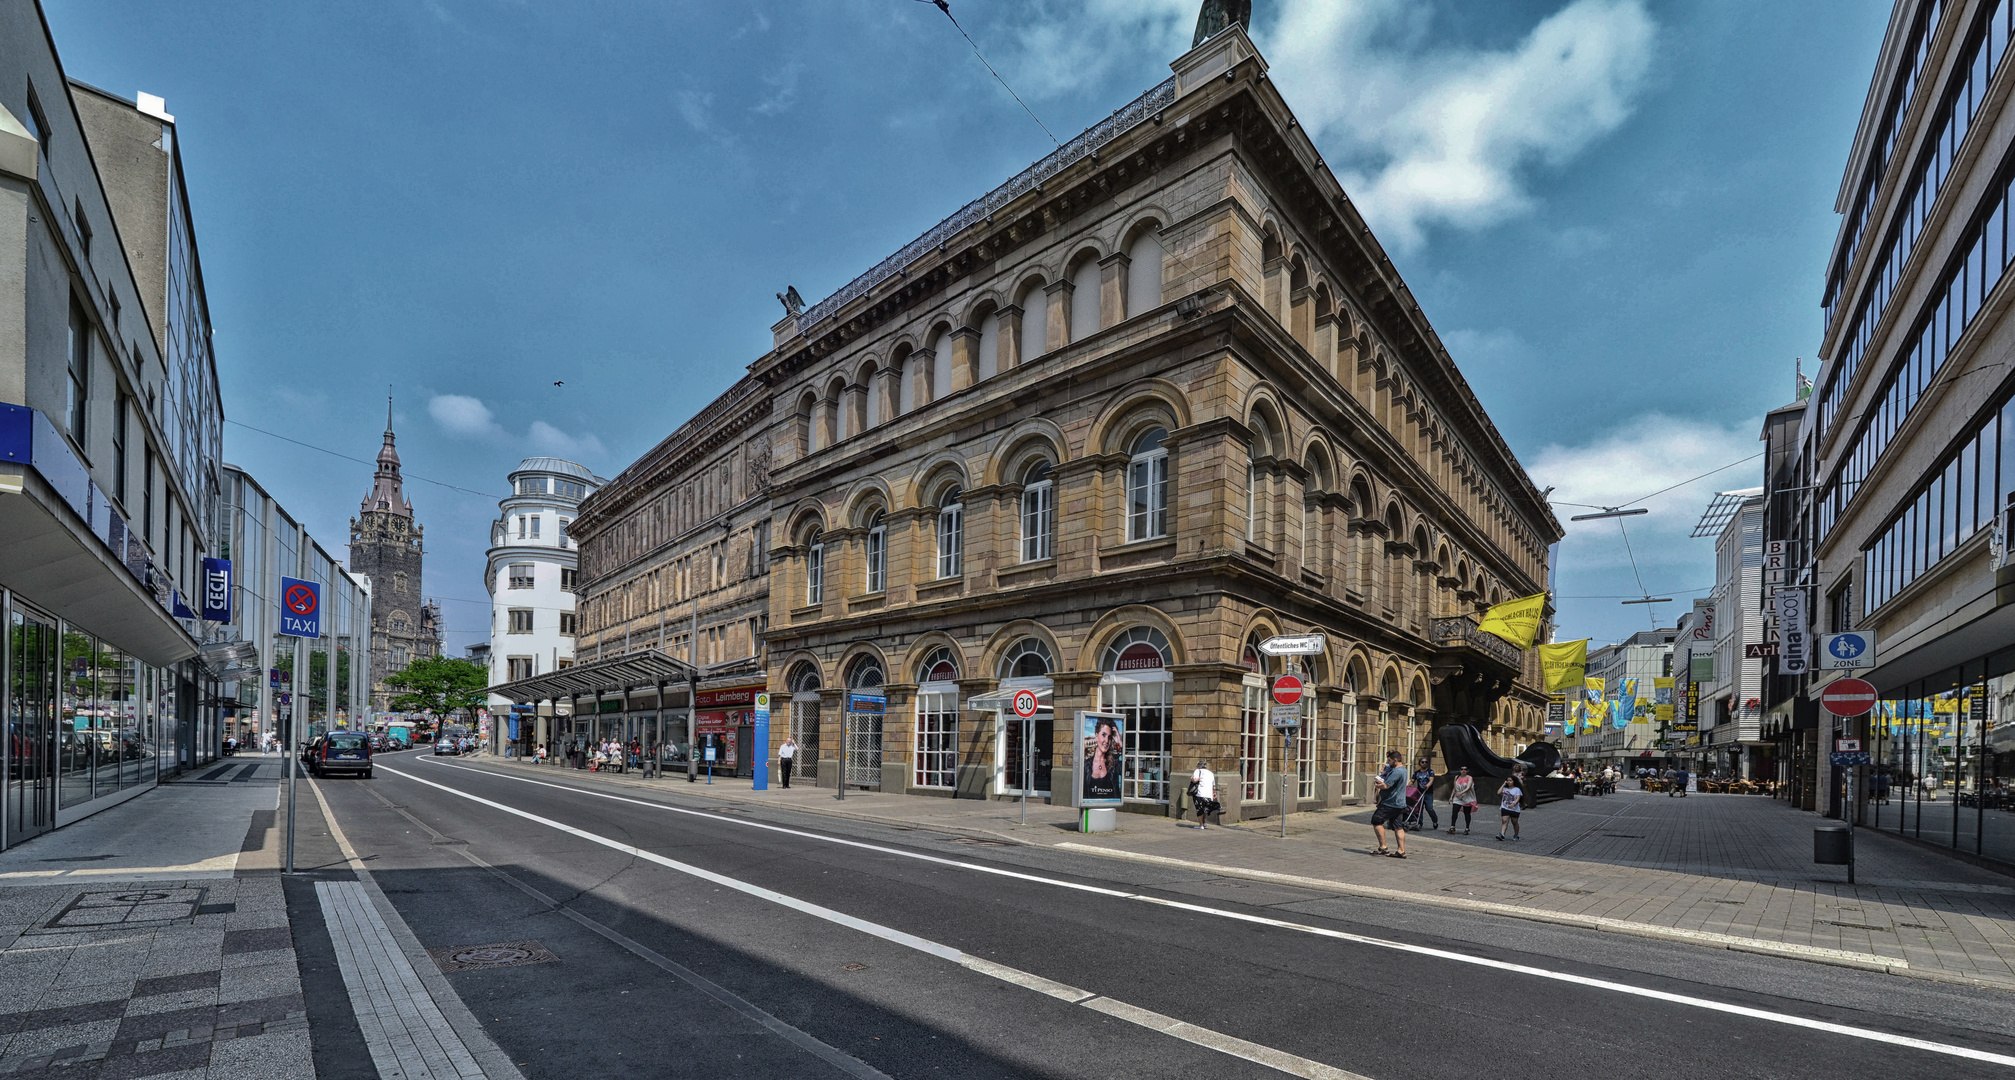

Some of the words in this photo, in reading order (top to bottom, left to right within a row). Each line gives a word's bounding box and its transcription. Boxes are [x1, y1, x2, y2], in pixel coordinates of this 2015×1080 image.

[210, 570, 225, 610] CECIL
[284, 617, 316, 633] TAXI
[1693, 607, 1714, 640] Pino's
[1270, 642, 1299, 650] Öffentliches
[1120, 657, 1160, 670] HAUSFELDER
[1833, 660, 1862, 668] ZONE
[695, 696, 711, 704] Foto
[715, 691, 750, 702] Leimberg
[1018, 697, 1033, 711] 30
[1673, 723, 1698, 731] Schuhe
